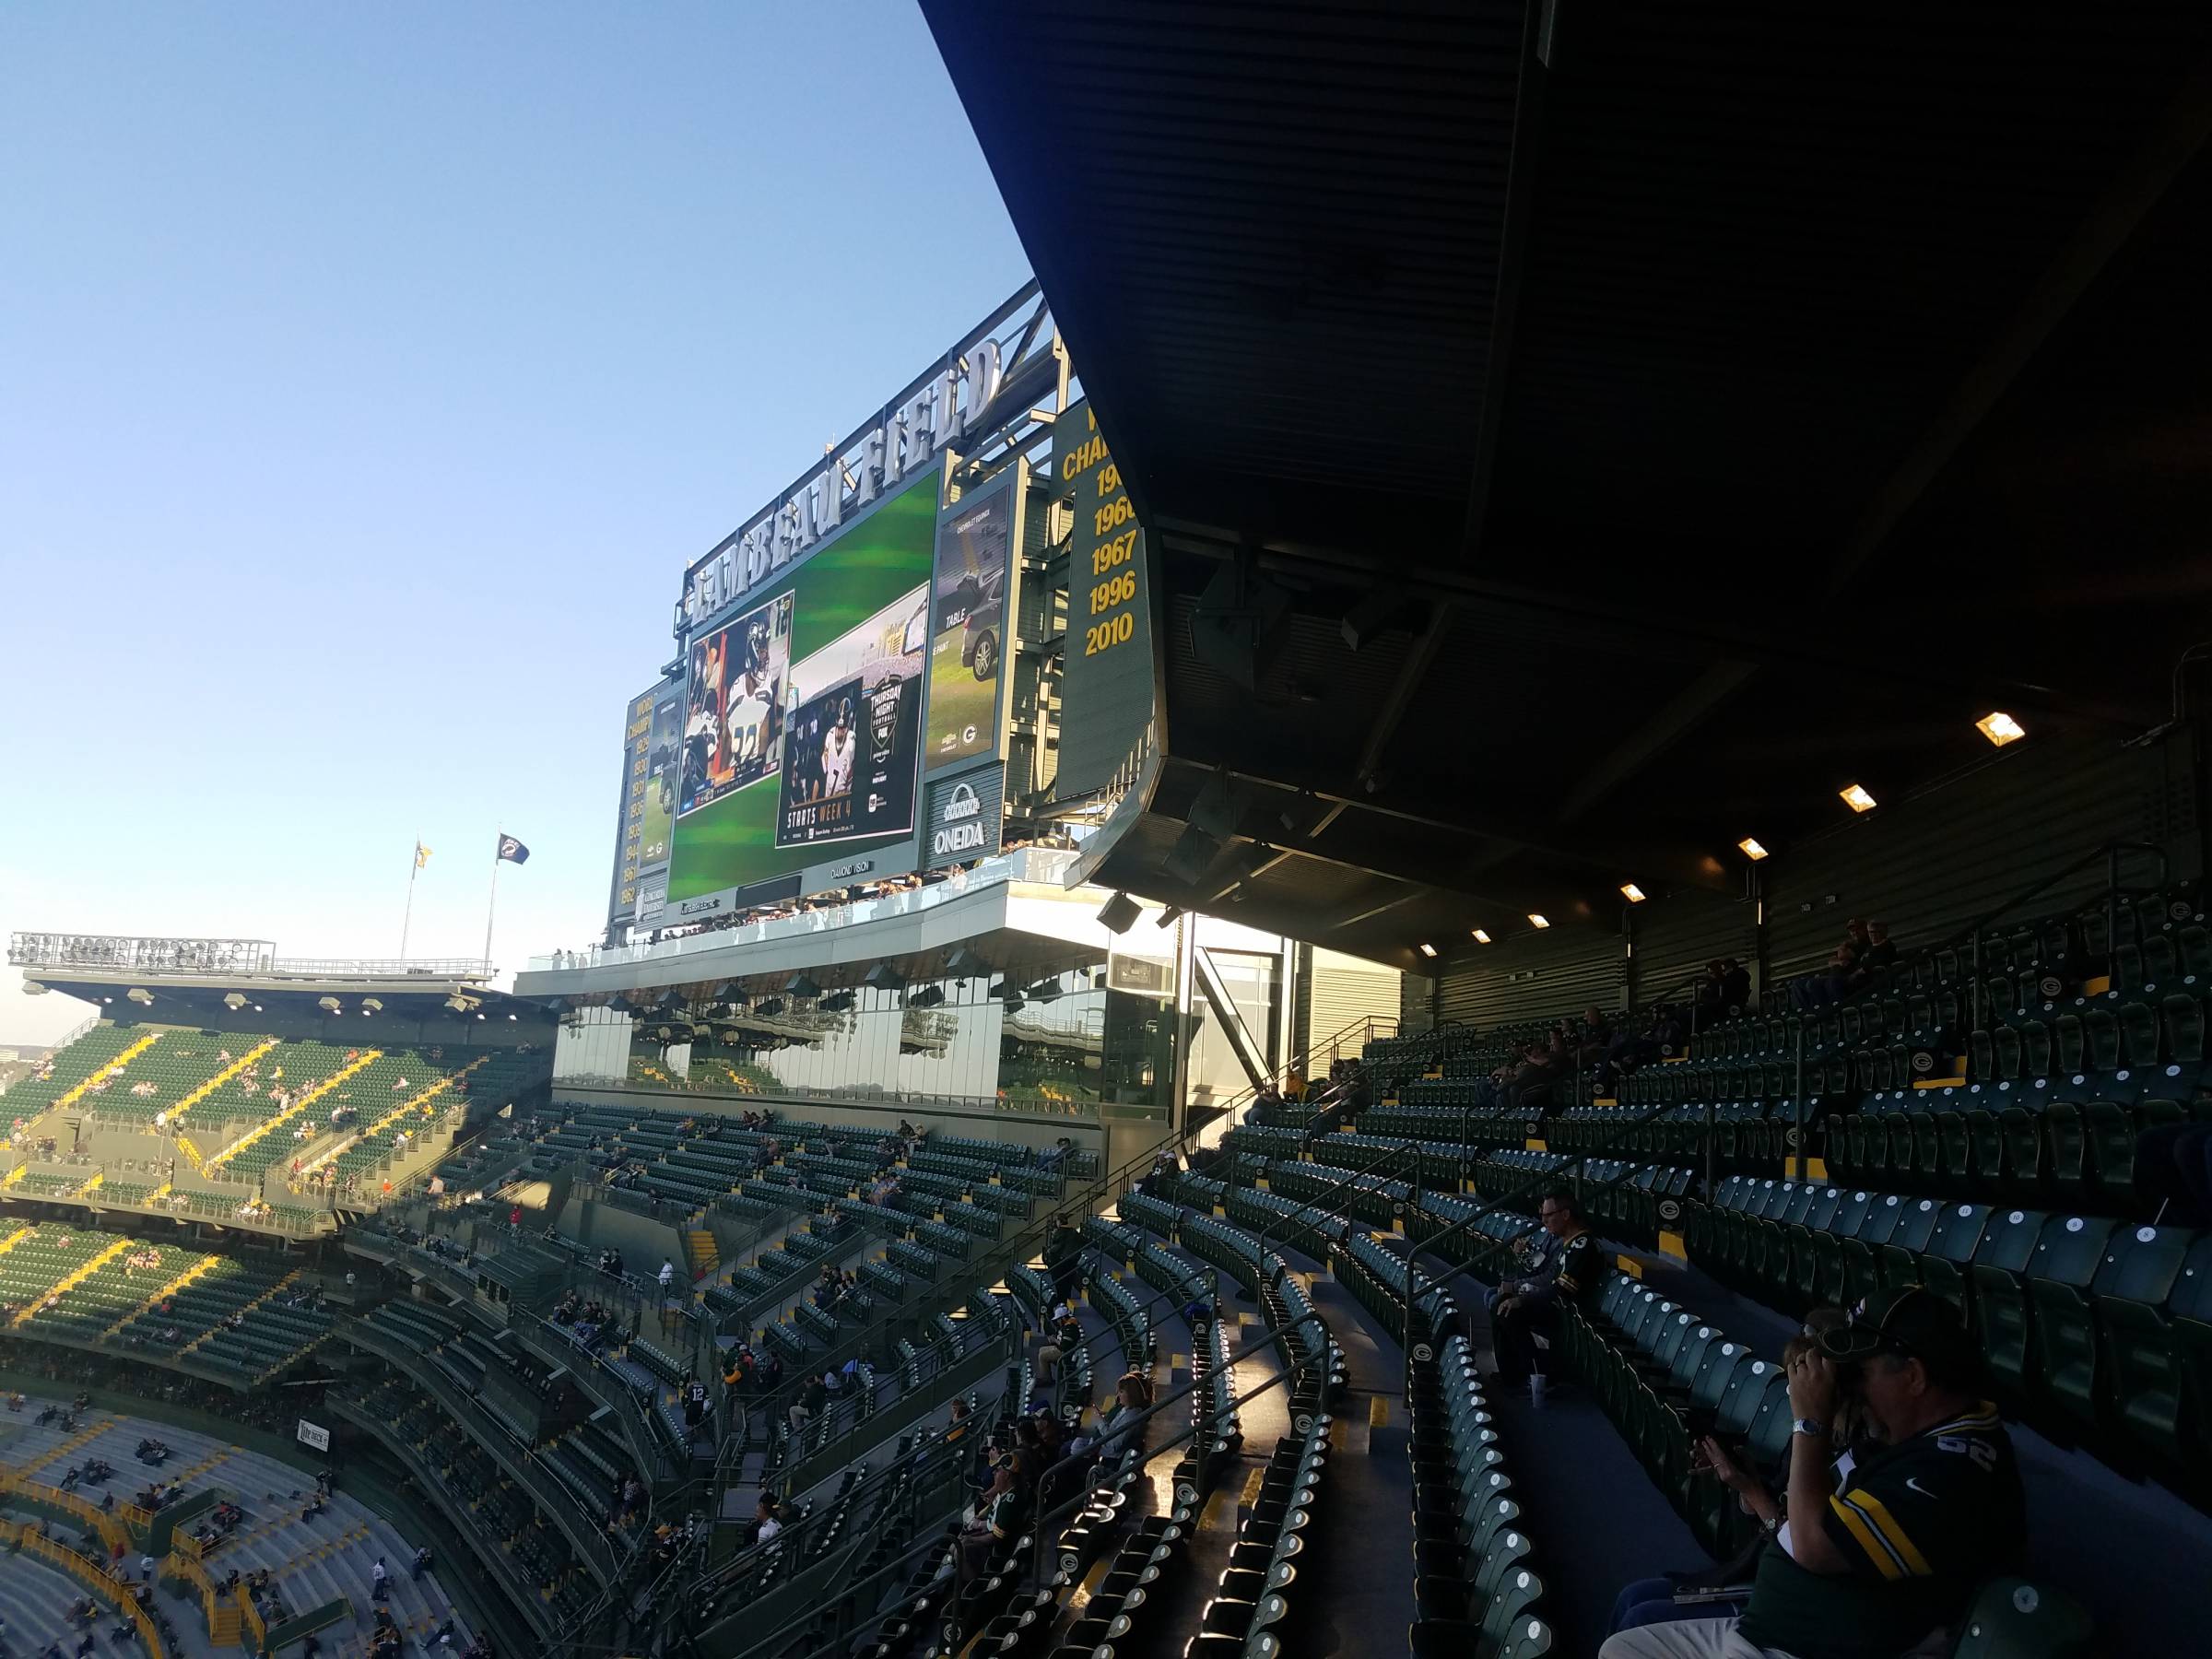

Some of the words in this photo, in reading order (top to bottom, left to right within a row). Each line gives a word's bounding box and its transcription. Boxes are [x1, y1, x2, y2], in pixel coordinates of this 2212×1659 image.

[690, 458, 843, 627] LAMBEAU
[858, 338, 1002, 507] FIELD
[1097, 464, 1122, 497] 19
[957, 517, 976, 535] CHEVROLET
[1091, 529, 1137, 575] 1967
[1089, 570, 1136, 615] 1996
[946, 607, 966, 629] TABLE
[1086, 611, 1134, 656] 2010
[871, 683, 902, 712] THURSDAY
[875, 700, 895, 718] NIGHT
[873, 712, 896, 727] FOOTBALL
[877, 726, 888, 739] FOX
[787, 807, 816, 829] STARTS
[818, 801, 842, 823] WEEK
[934, 821, 985, 854] ONEIDA
[830, 865, 853, 879] DIAMOND
[853, 860, 869, 875] VISION
